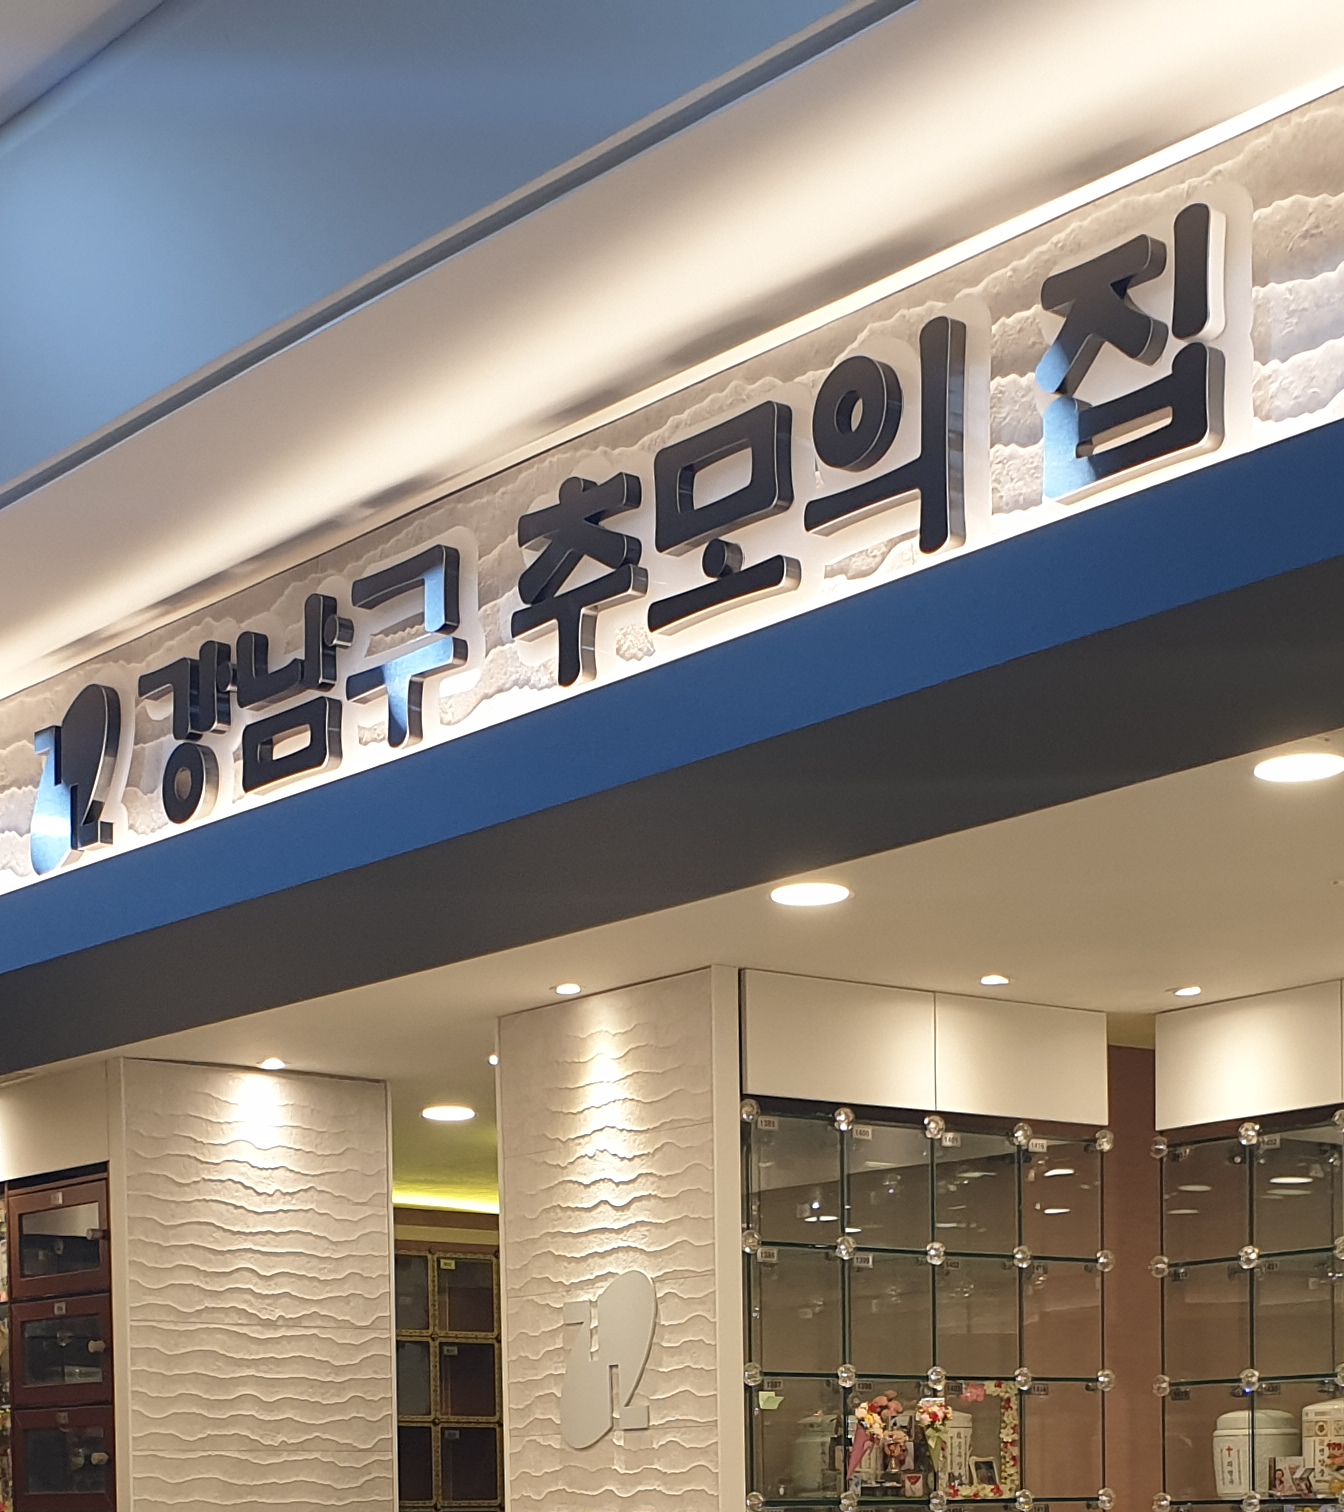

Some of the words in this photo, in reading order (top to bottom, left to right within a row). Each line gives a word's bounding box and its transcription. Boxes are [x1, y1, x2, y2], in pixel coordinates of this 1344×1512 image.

[138, 543, 468, 824] 강남구
[512, 314, 967, 687] 추모의
[1037, 202, 1226, 499] 집
